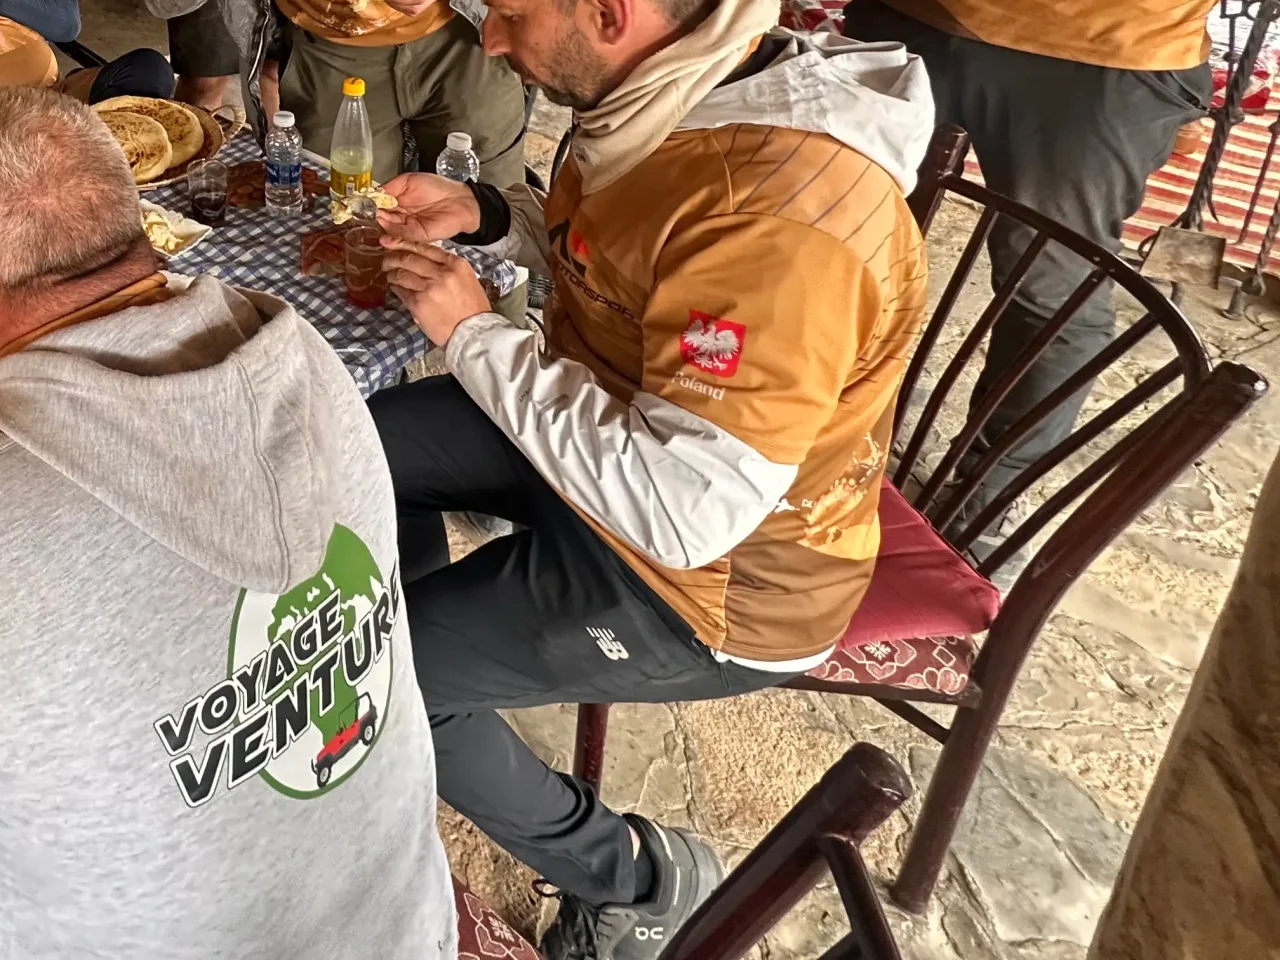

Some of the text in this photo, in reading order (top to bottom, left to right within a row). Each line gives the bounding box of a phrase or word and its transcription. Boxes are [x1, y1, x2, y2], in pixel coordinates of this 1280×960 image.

[671, 370, 726, 401] Poland
[154, 588, 344, 756] VOYAGE
[170, 558, 400, 808] VENTURE
